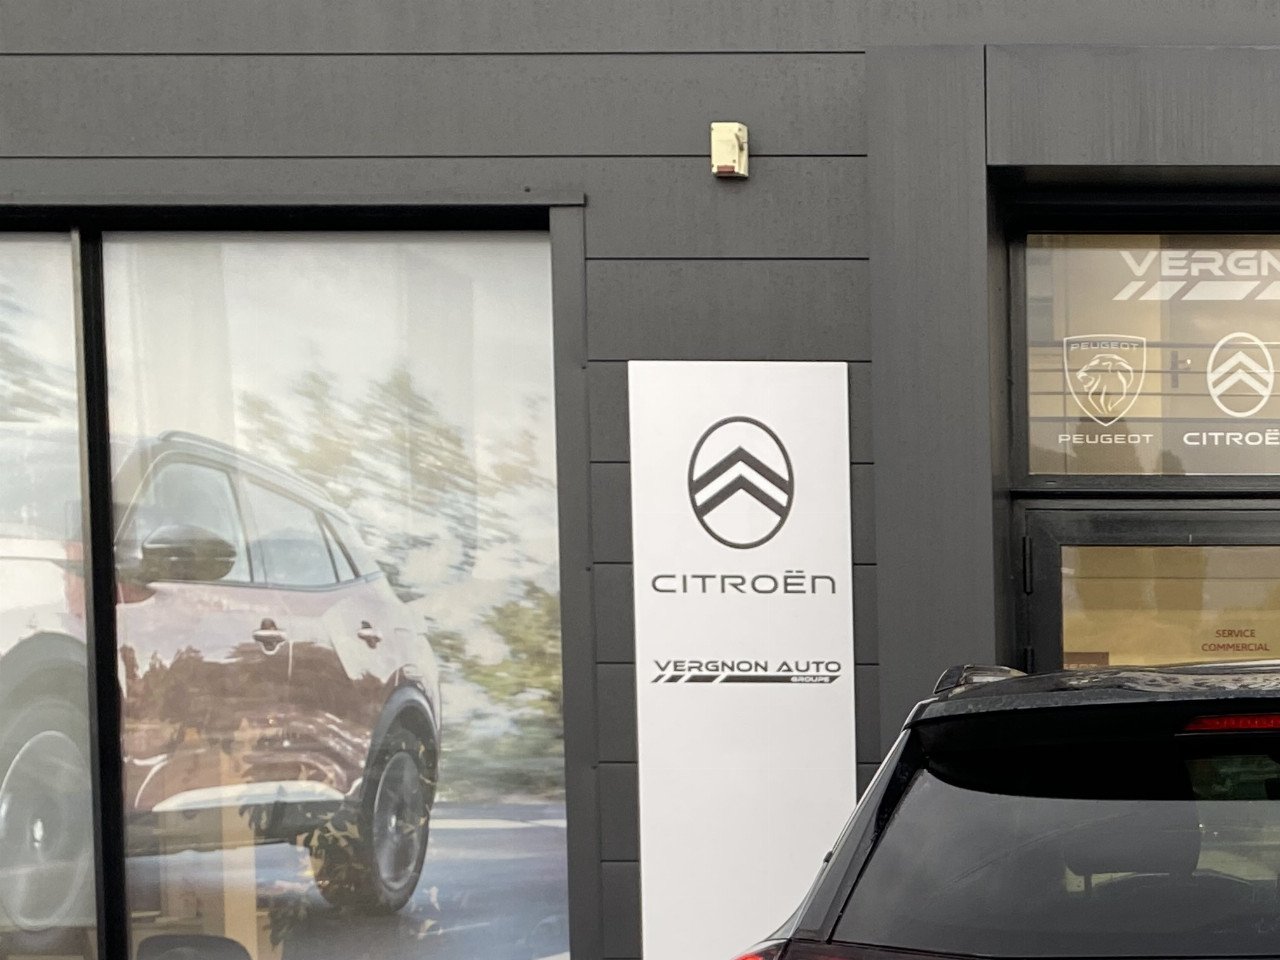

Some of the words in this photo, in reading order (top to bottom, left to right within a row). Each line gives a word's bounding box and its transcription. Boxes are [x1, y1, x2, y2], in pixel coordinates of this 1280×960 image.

[1069, 341, 1140, 352] PEUGEOT
[1057, 433, 1154, 445] PEUGEOT
[1215, 629, 1256, 638] SERVICE
[1201, 642, 1271, 652] COMMERCIAL
[652, 659, 769, 673] VERGNON
[776, 660, 842, 673] AUTO
